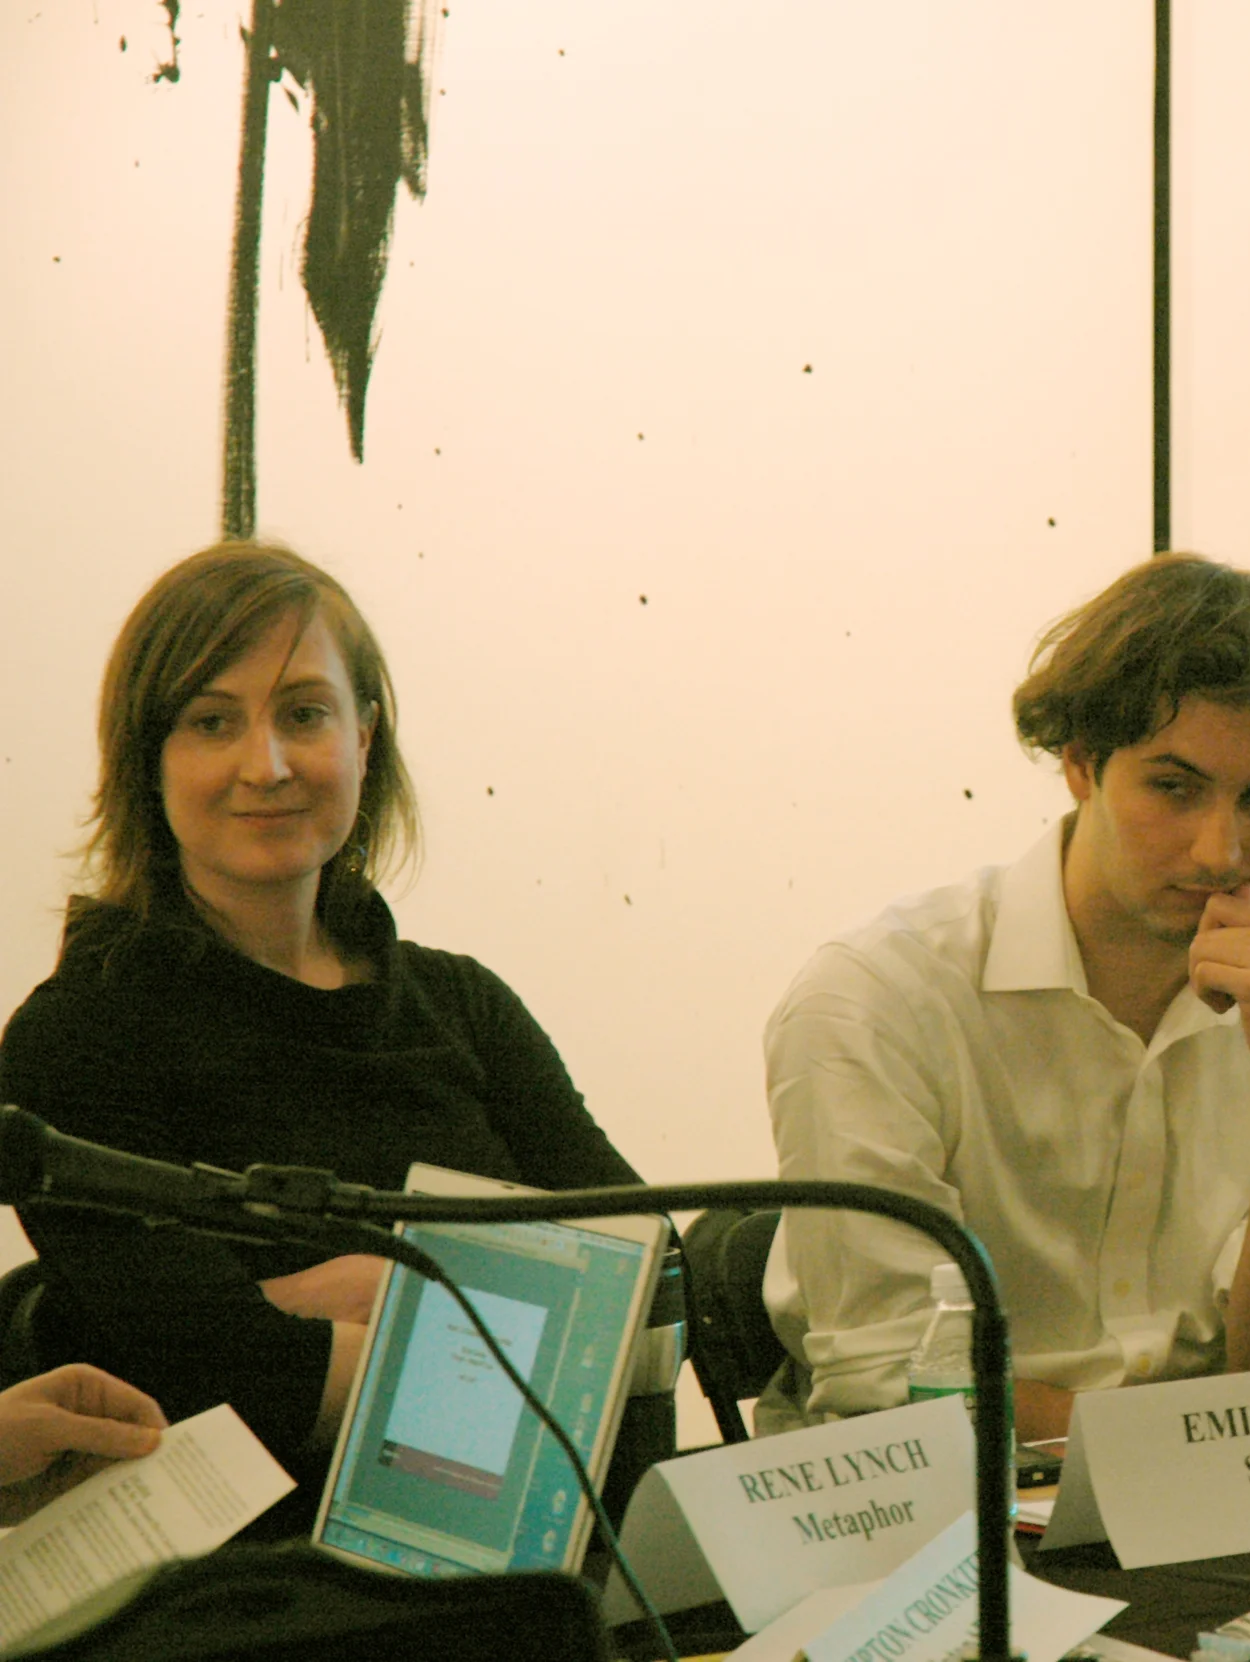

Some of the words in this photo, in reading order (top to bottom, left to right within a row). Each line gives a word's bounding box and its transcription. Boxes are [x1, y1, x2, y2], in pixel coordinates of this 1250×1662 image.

[738, 1460, 823, 1503] RENE
[825, 1438, 931, 1484] LYNCH
[792, 1498, 915, 1545] Metaphor
[843, 1617, 912, 1662] PTON
[904, 1550, 979, 1634] CRONKIT
